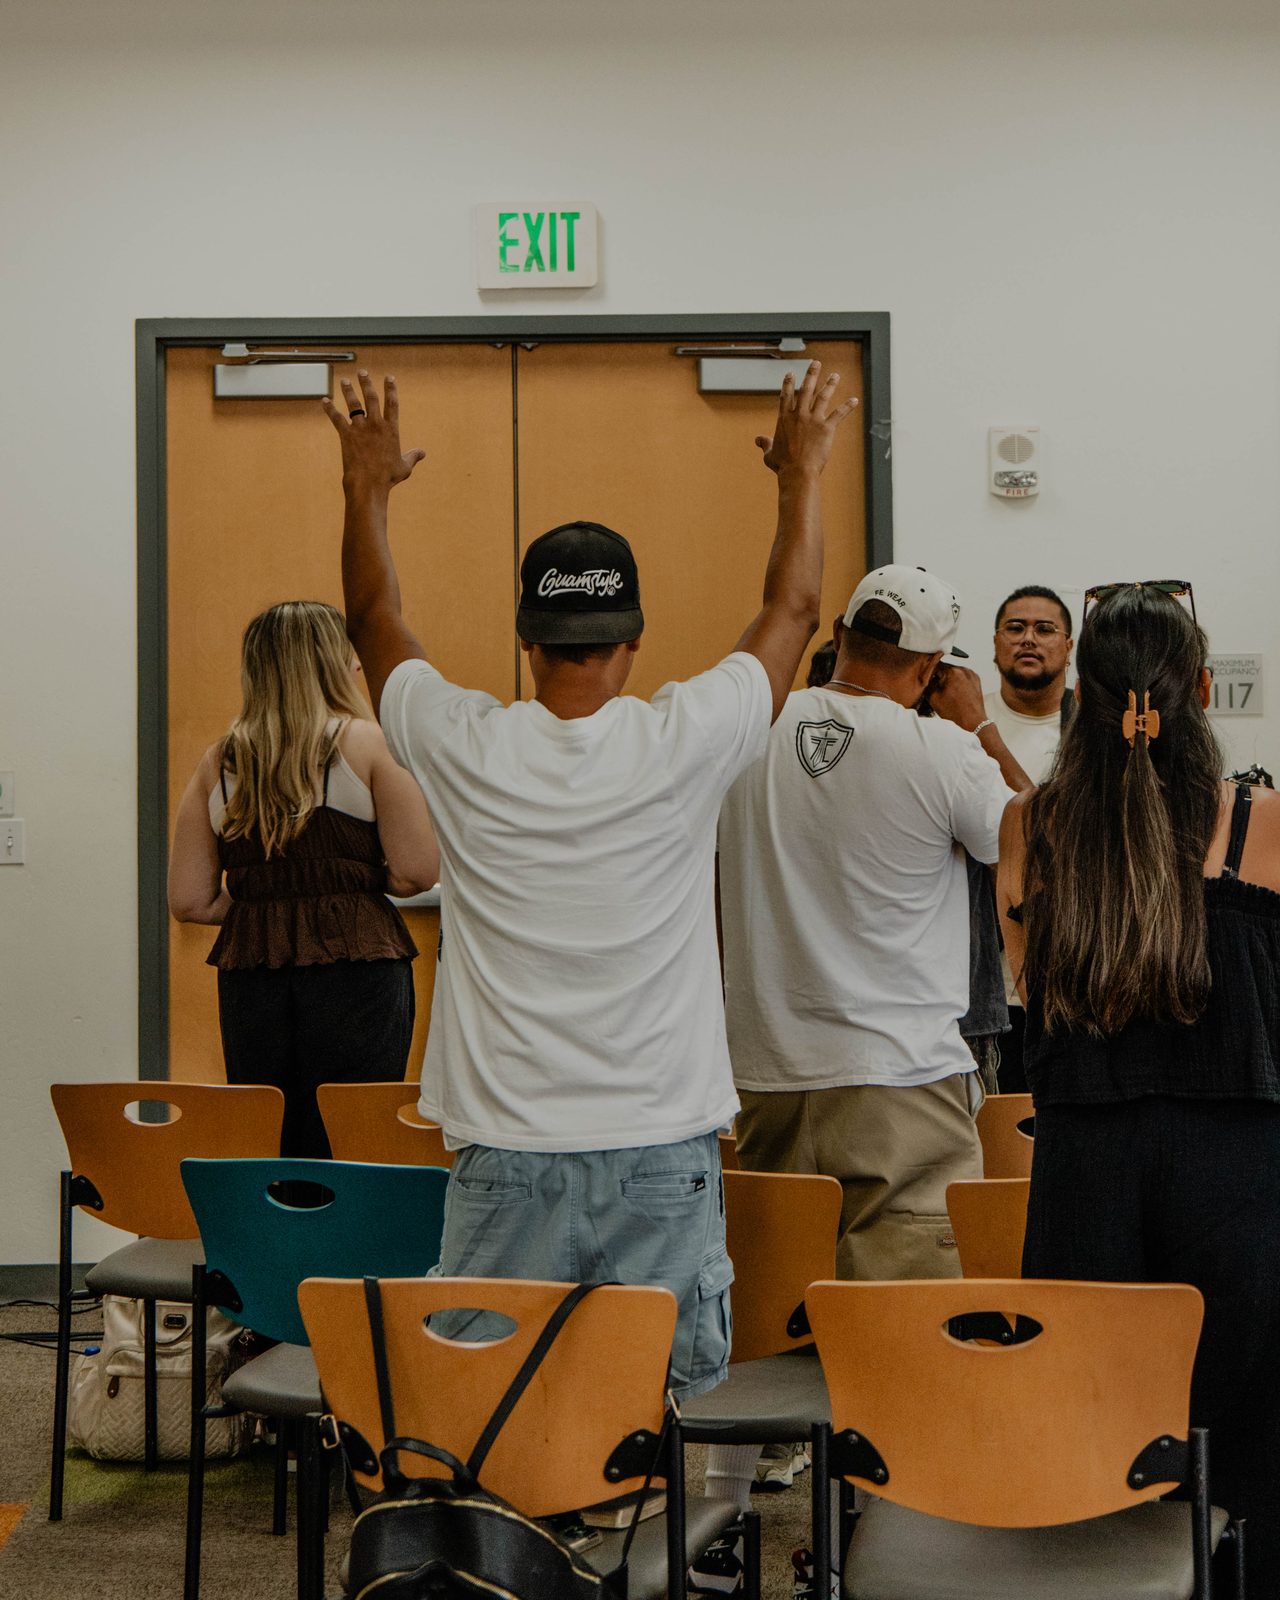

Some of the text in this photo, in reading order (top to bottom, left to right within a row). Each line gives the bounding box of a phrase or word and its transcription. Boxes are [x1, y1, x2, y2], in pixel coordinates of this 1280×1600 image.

[499, 212, 580, 272] EXIT
[1006, 488, 1029, 496] FIRE
[887, 590, 906, 608] WEAR
[1212, 667, 1261, 676] CCUPANCY
[1214, 683, 1254, 709] 117
